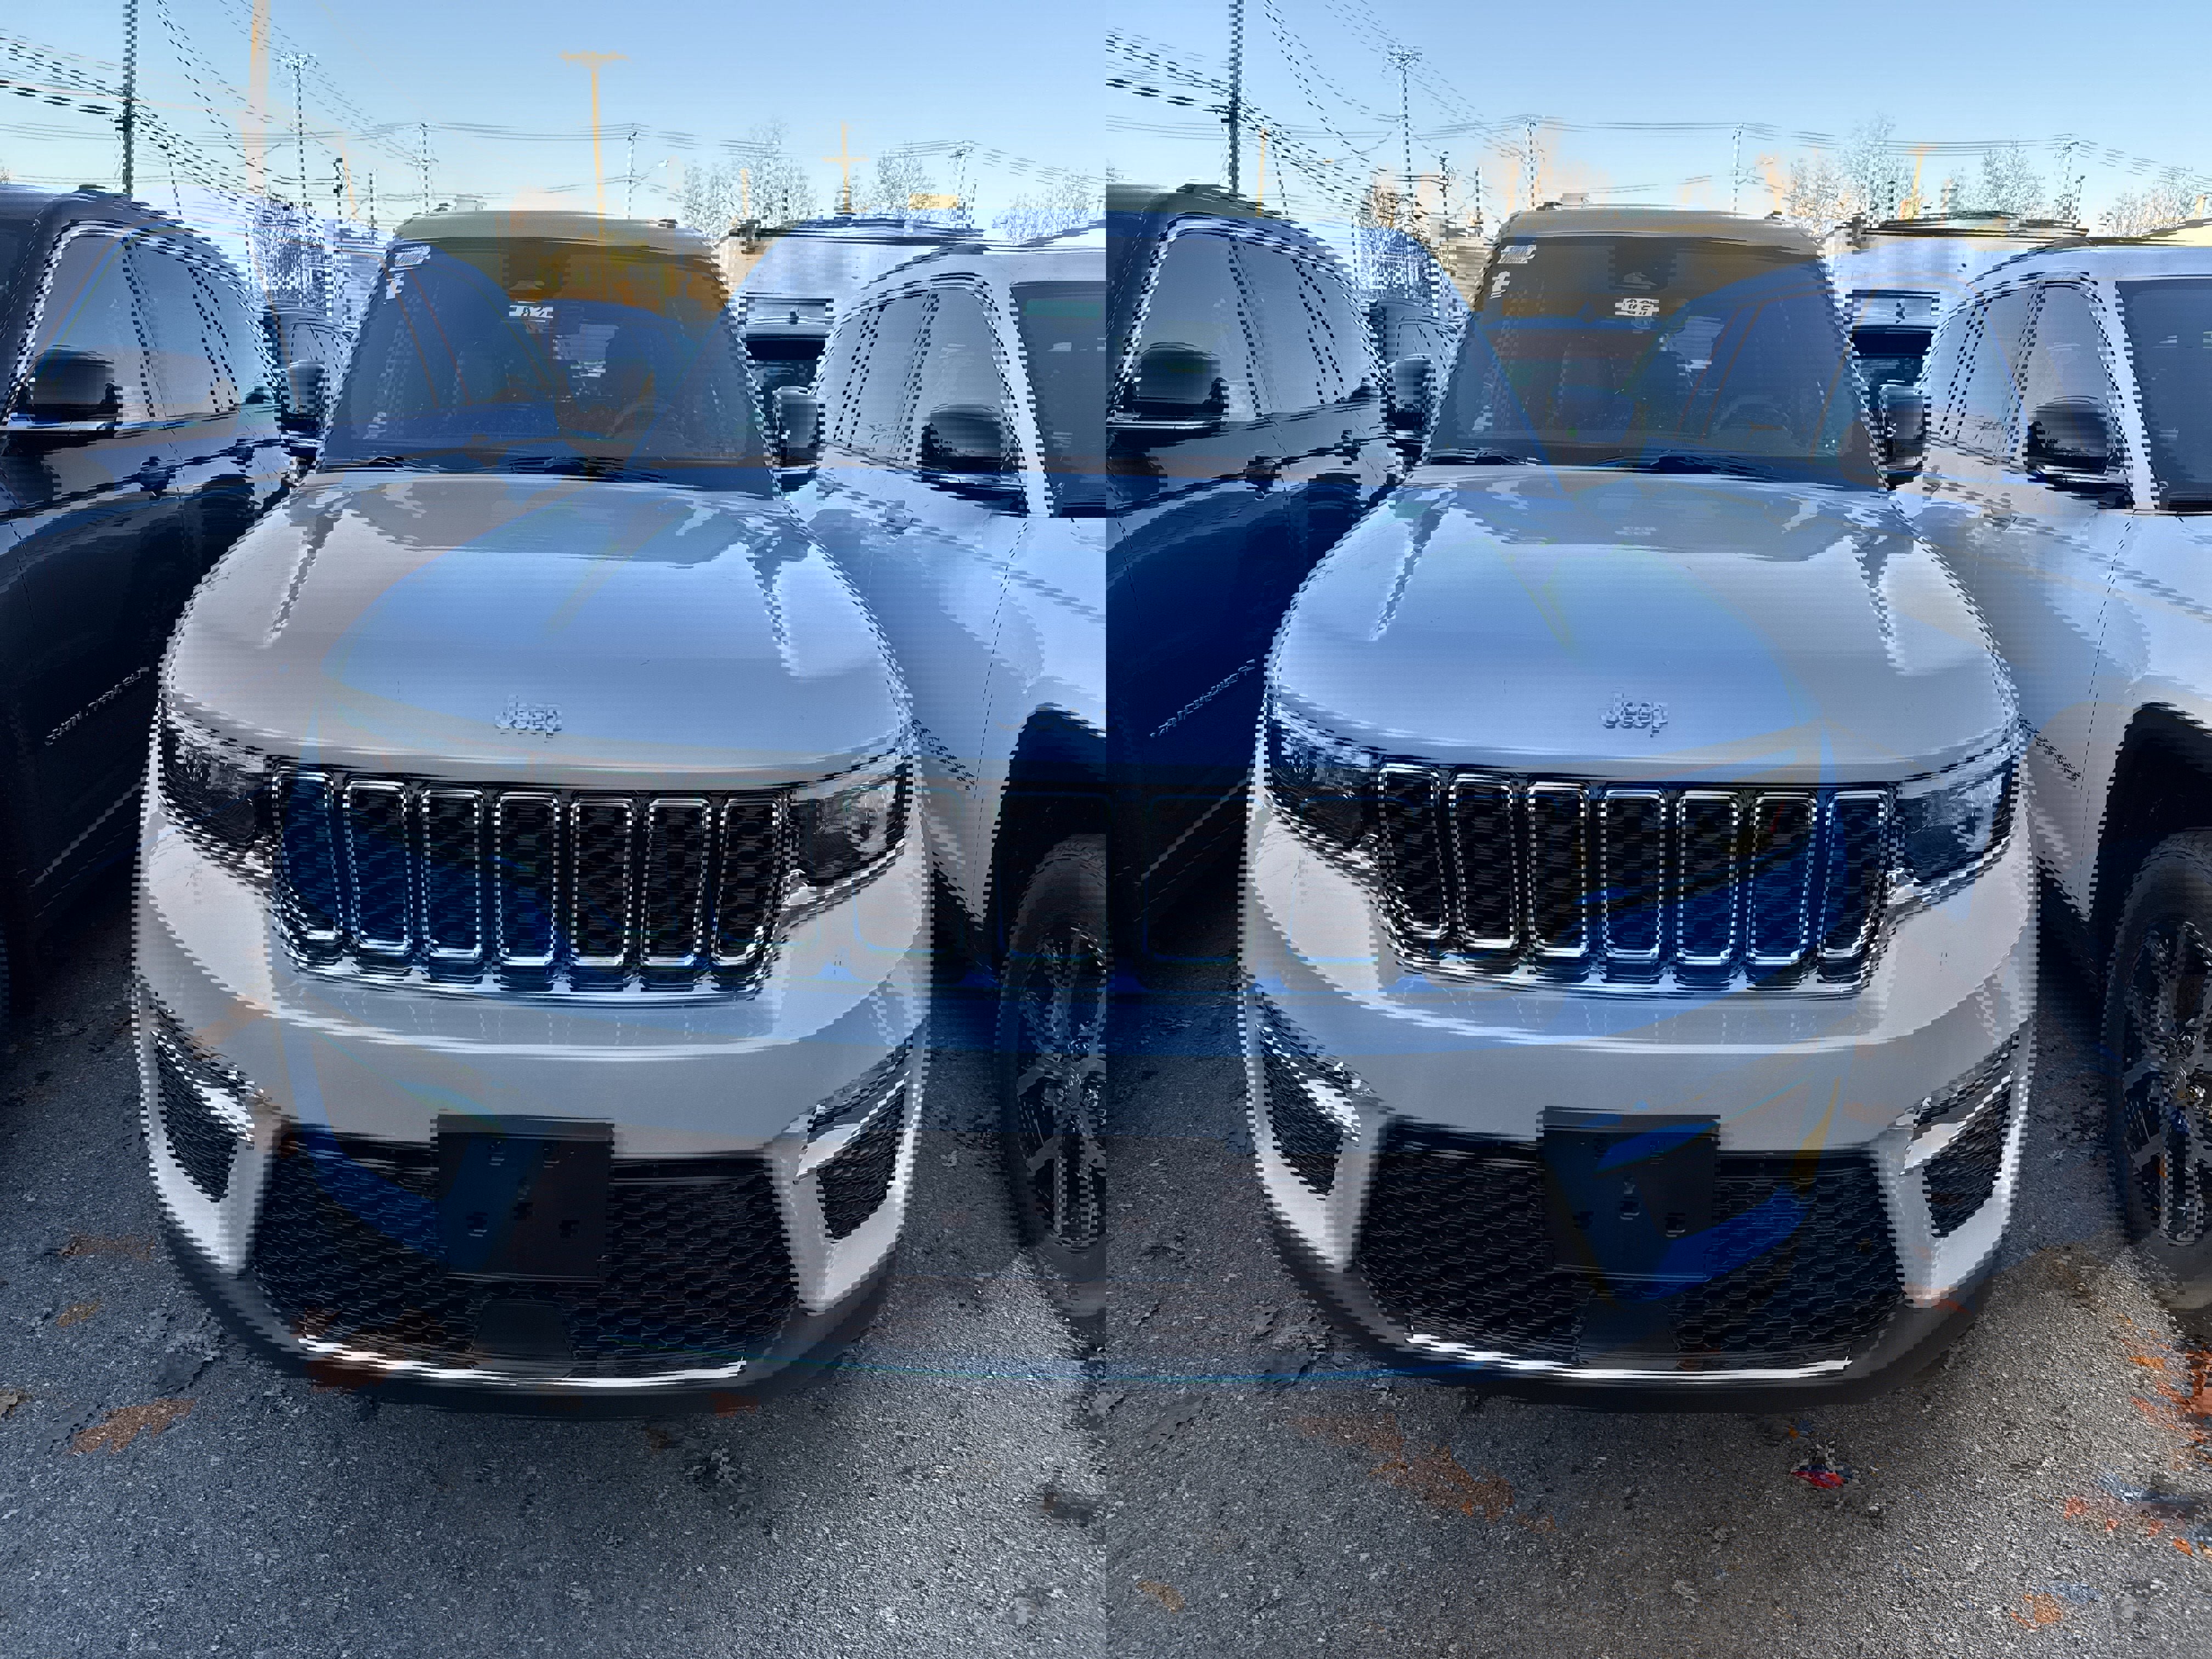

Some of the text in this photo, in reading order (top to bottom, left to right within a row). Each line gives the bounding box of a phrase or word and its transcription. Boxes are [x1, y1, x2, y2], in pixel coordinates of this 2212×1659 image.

[1038, 303, 1090, 315] 18127
[97, 669, 275, 742] GRAND CHEROKEE
[994, 692, 1120, 738] Jeep
[1859, 733, 1945, 787] CHEROKEE
